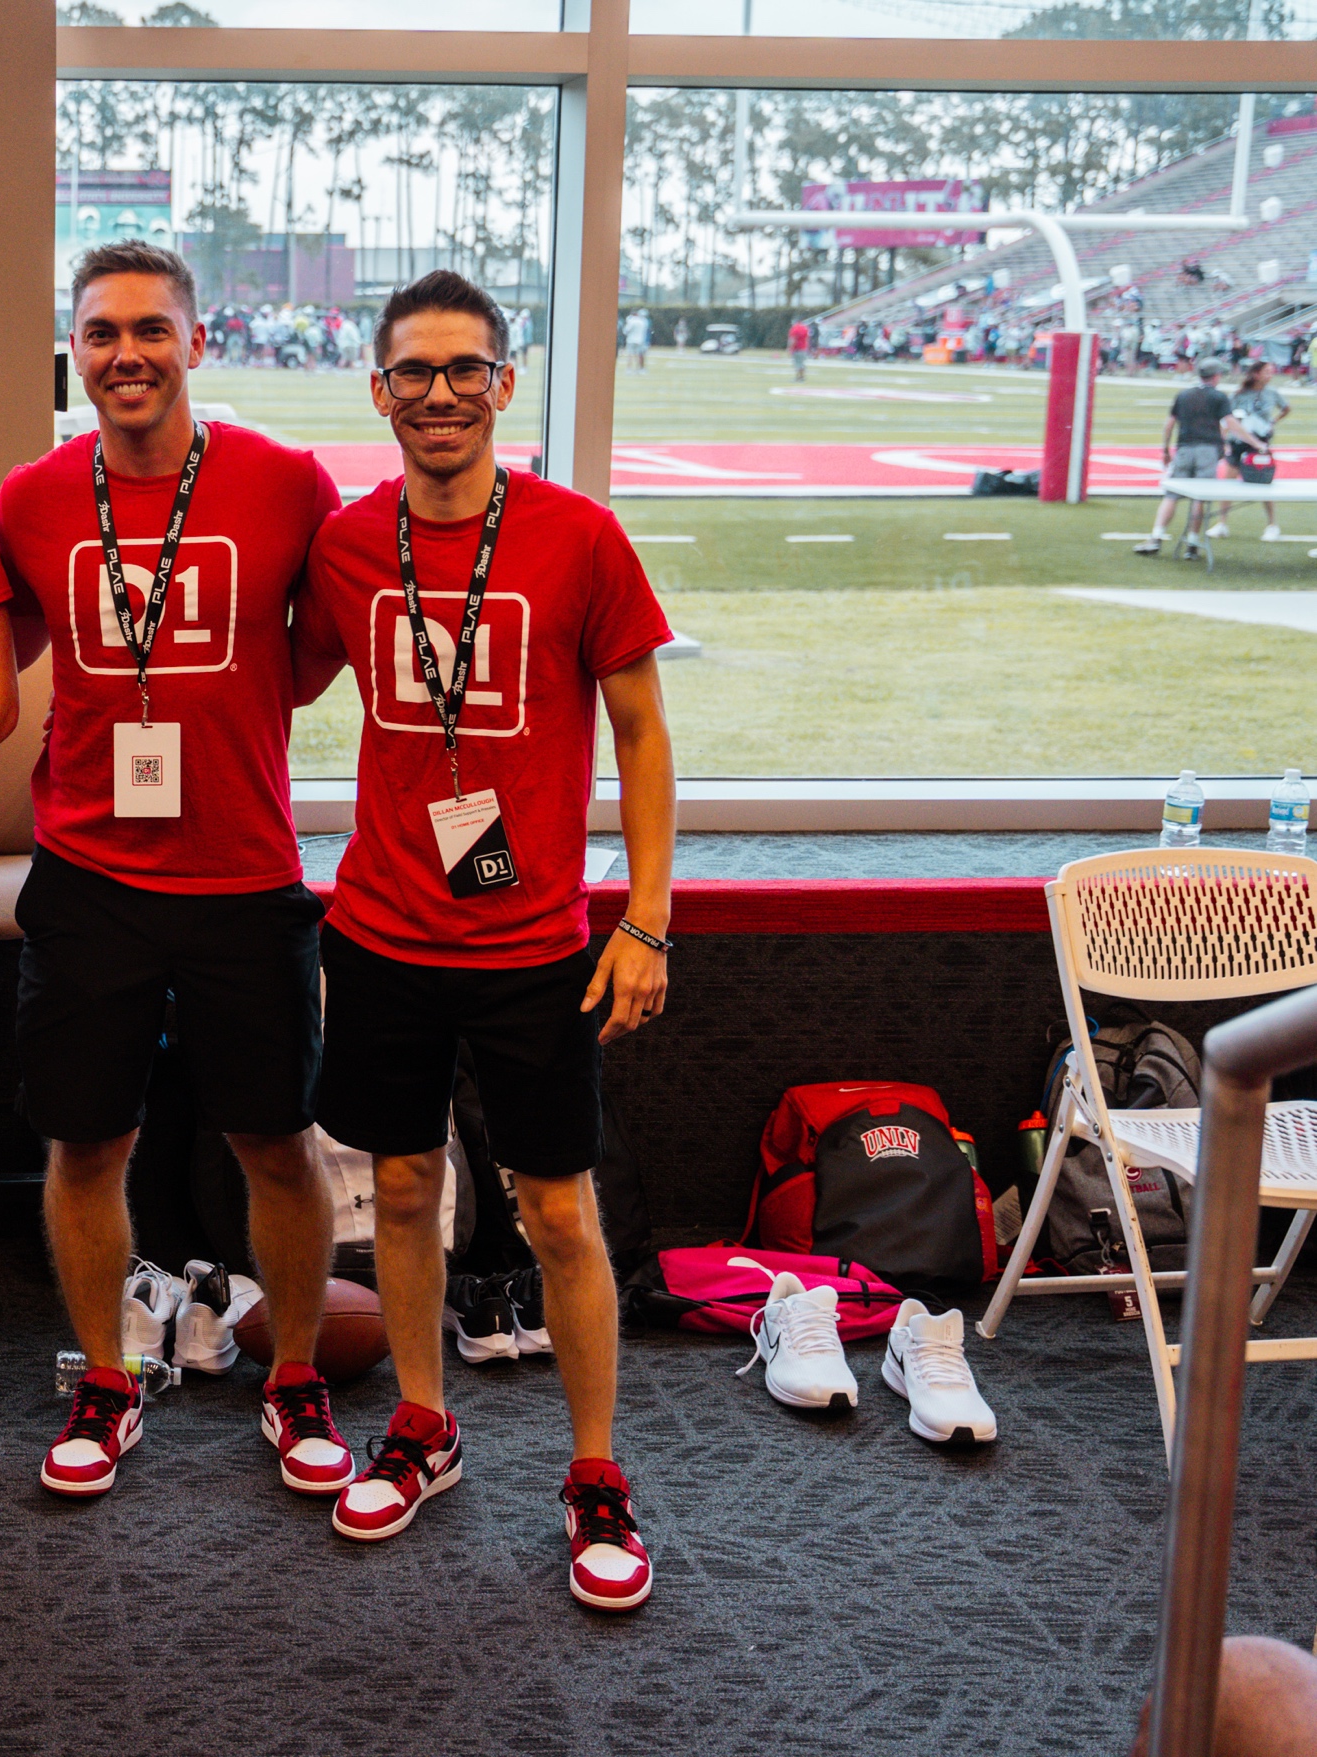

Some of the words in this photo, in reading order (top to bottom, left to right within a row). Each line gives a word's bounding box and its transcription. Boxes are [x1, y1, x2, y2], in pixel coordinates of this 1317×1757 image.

[94, 442, 105, 486] PLAE
[98, 500, 111, 533] Dashr
[486, 482, 505, 528] PLAE
[142, 620, 157, 654] Dashr
[151, 557, 172, 604] PLAE
[166, 510, 184, 543] Dashr
[179, 450, 200, 495] PLAE
[399, 516, 411, 564] PLAE
[106, 547, 125, 595] PLAE
[473, 544, 492, 579] Dashr
[98, 563, 211, 647] D1
[404, 580, 418, 615] Dashr
[118, 607, 133, 642] Dashr
[461, 593, 481, 643] PLAE
[394, 615, 503, 707] D1
[415, 631, 437, 680] PLAE
[451, 660, 468, 696] Dashr
[447, 713, 458, 749] LAE
[432, 807, 454, 817] DILLAN
[454, 798, 494, 811] MCCULLOUGH
[480, 857, 509, 879] D1
[629, 926, 645, 939] FOR
[643, 935, 660, 948] PRAY
[860, 1125, 921, 1158] UNLV
[1124, 1295, 1134, 1308] 5
